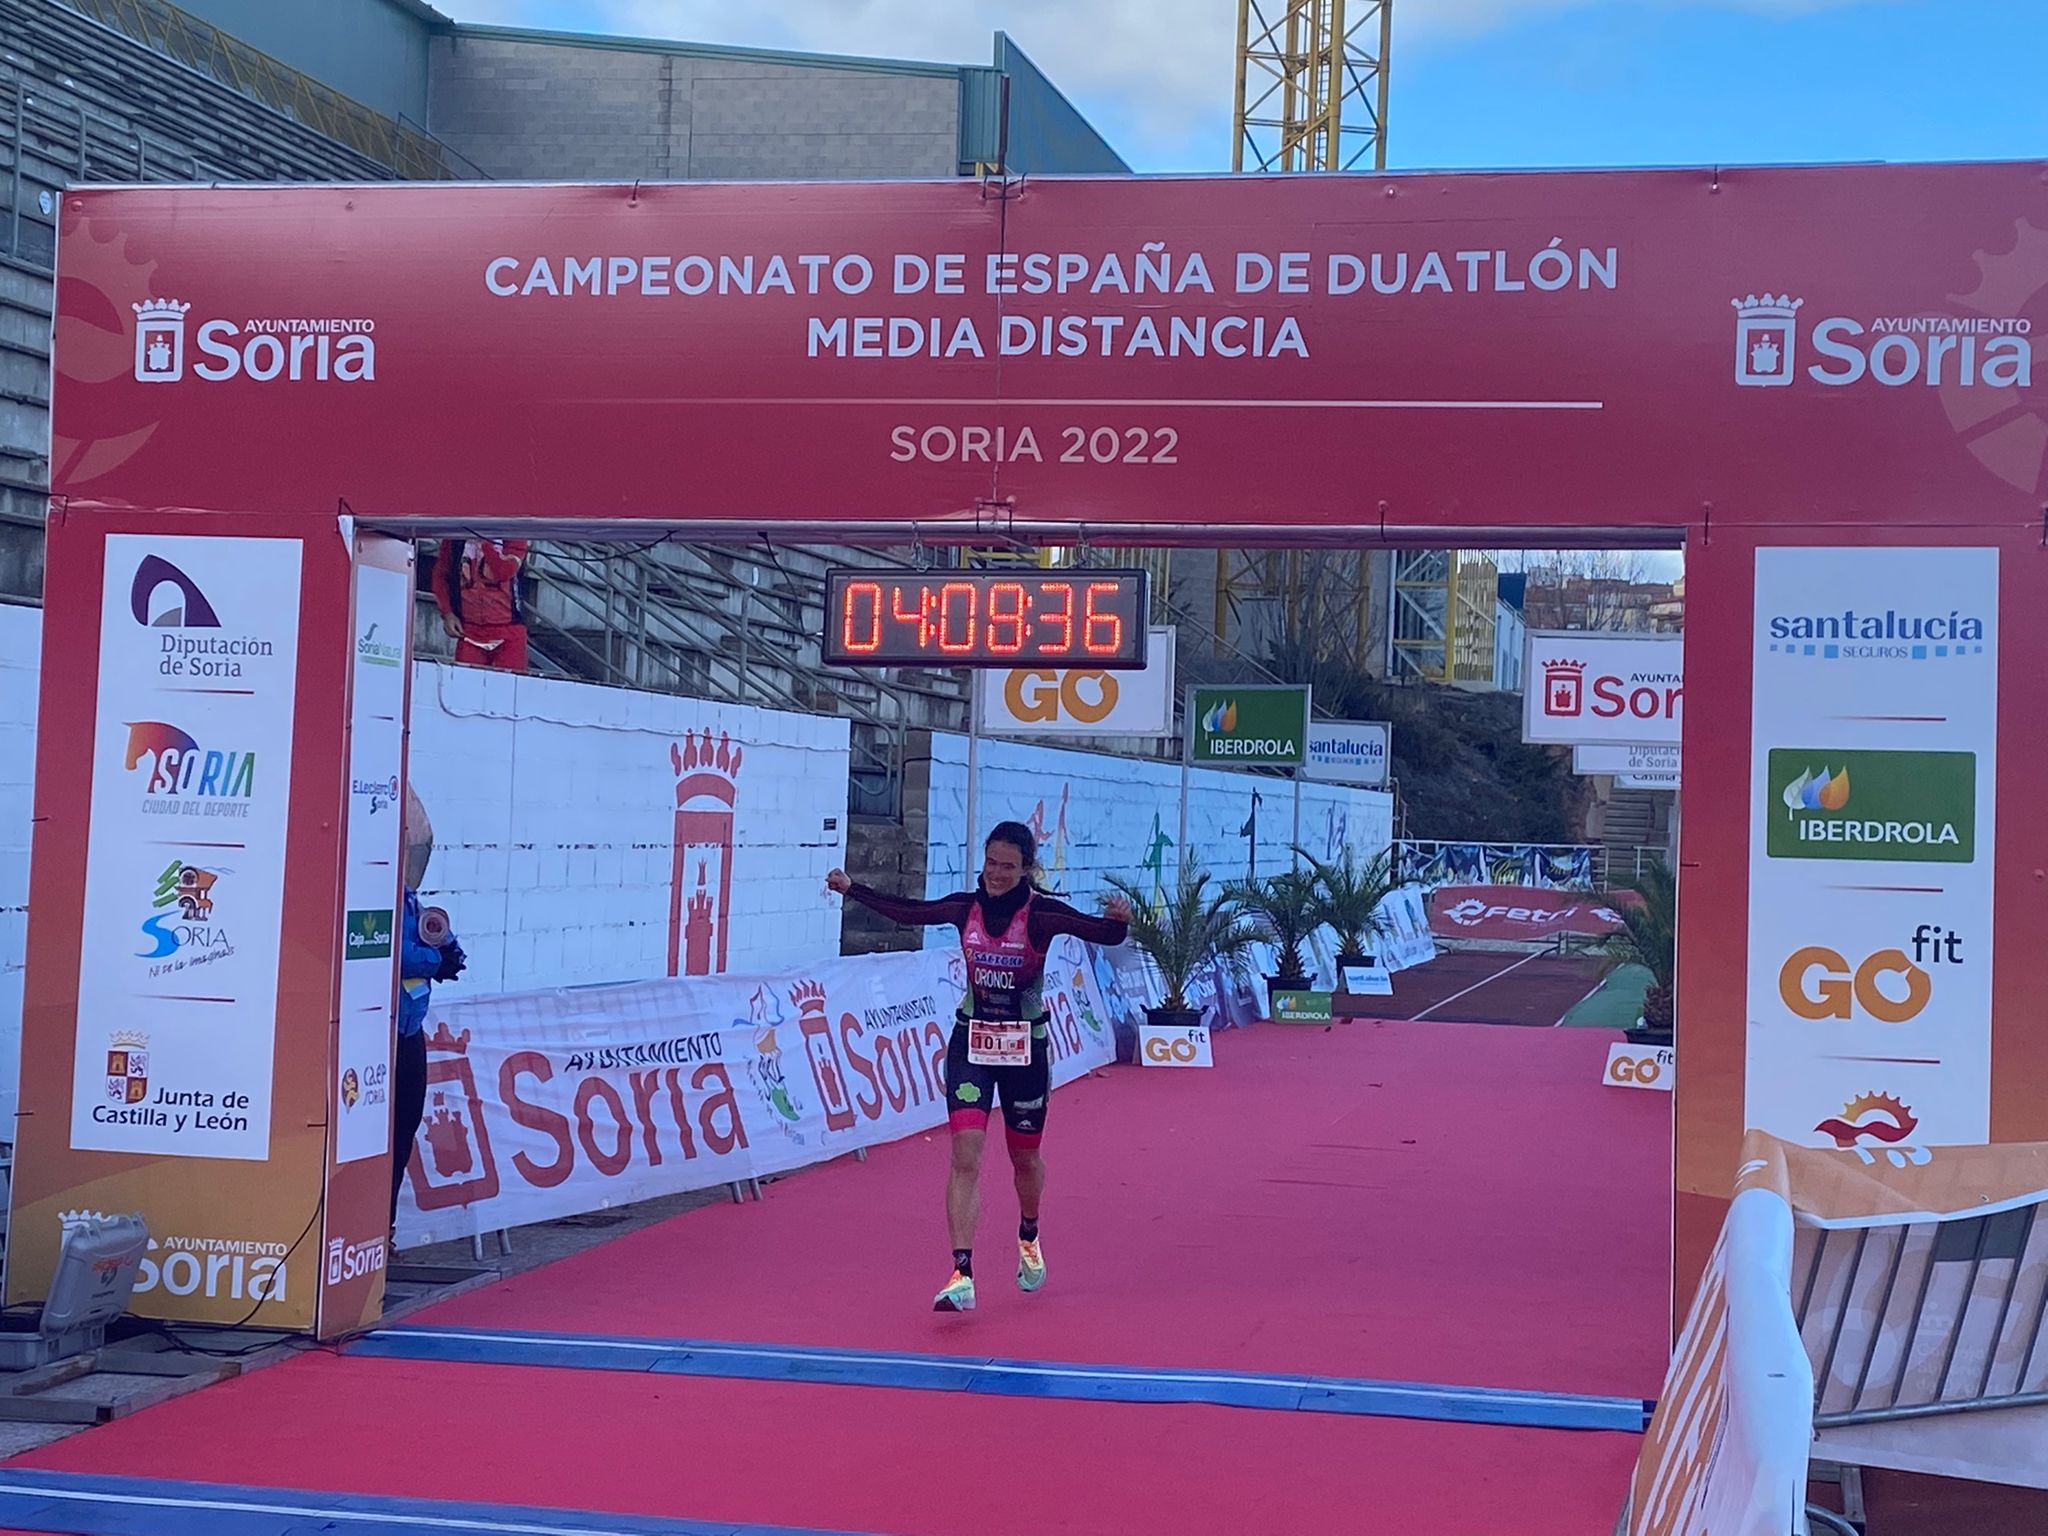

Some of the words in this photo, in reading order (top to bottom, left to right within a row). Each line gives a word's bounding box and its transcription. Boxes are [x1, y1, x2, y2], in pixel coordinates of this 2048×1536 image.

[484, 254, 874, 297] CAMPEONATO
[893, 253, 965, 295] DE
[986, 241, 1214, 296] ESPAÑA
[1235, 252, 1310, 294] DE
[1327, 238, 1618, 295] DUATLÓN
[244, 319, 375, 333] AYUNTAMIENTO
[807, 317, 985, 358] MEDIA
[1000, 315, 1310, 358] DISTANCIA
[1870, 317, 2032, 334] AYUNTAMIENTO
[193, 319, 376, 382] Soria
[1807, 317, 2032, 388] Soria
[889, 426, 1043, 463] SORIA
[1060, 426, 1179, 463] 2022
[1769, 609, 1983, 641] santalucía
[161, 633, 274, 659] Diputación
[1842, 645, 1909, 659] SEGUROS
[160, 655, 183, 676] de
[189, 657, 242, 678] Soria
[1004, 668, 1120, 724] GO
[1210, 739, 1296, 756] IBERDROLA
[1628, 756, 1643, 768] de
[1646, 756, 1678, 768] Soria
[149, 747, 256, 798] SORIA
[142, 800, 181, 815] CIUDAD
[182, 801, 201, 816] DEL
[203, 802, 250, 818] DEPORTE
[1799, 820, 1960, 845] IBERDROLA
[134, 910, 230, 959] SORIA
[1779, 946, 1932, 1023] GO
[1911, 924, 1964, 964] fit
[863, 995, 937, 1031] AYUNTAMIENTO
[564, 1032, 723, 1072] AYUNTAMIENTO
[1145, 1036, 1197, 1063] GO
[1188, 1029, 1206, 1043] fit
[839, 1011, 948, 1121] Soria
[1610, 1055, 1661, 1084] GO
[1656, 1049, 1674, 1065] fit
[153, 1087, 214, 1108] Junta
[222, 1091, 250, 1110] de
[92, 1105, 168, 1127] Castilla
[173, 1113, 188, 1133] y
[194, 1111, 248, 1131] León
[498, 1050, 750, 1189] Soria
[163, 1236, 288, 1257] AYUNTAMIENTO
[343, 1244, 385, 1280] Soria
